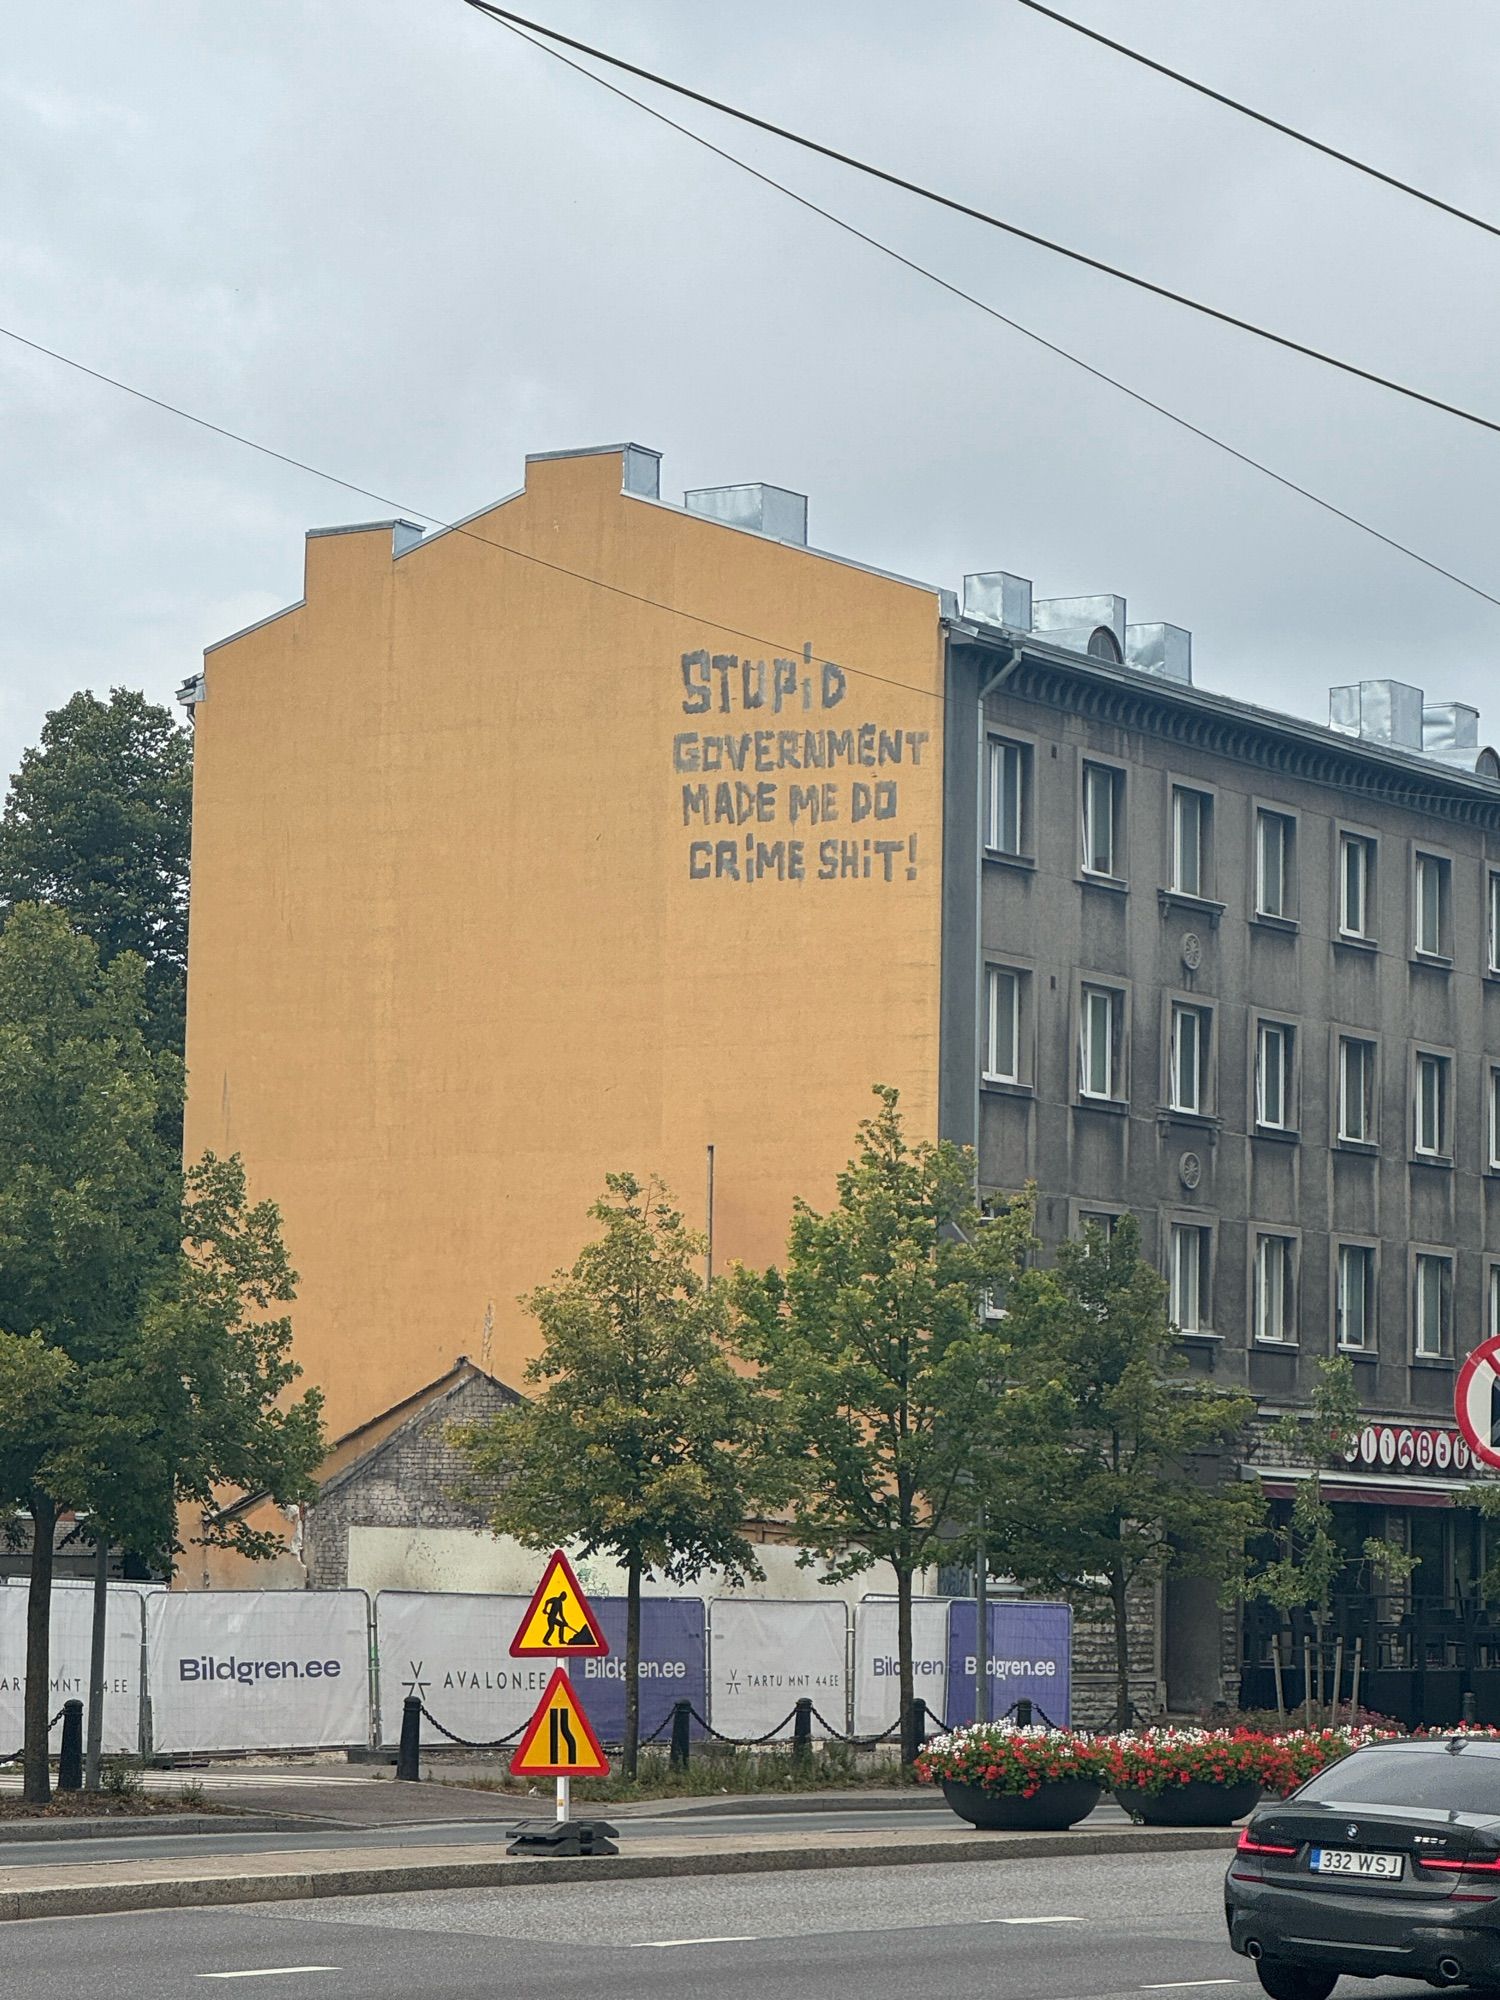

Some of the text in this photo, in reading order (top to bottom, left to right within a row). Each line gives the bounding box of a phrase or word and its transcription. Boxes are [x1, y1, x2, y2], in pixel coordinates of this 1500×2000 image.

[673, 722, 929, 774] GOVERNMENT
[682, 780, 897, 826] MADE ME DO
[180, 1656, 341, 1686] Bildgren.ee
[585, 1656, 686, 1681] Bildgen.ee
[965, 1655, 1055, 1680] Bdgren.ee
[50, 1679, 81, 1692] MNT
[443, 1671, 547, 1690] AVALON.EE
[747, 1675, 783, 1687] TARTU
[788, 1675, 810, 1687] MNT
[1324, 1852, 1352, 1870] 332
[1358, 1854, 1398, 1874] WSJ
